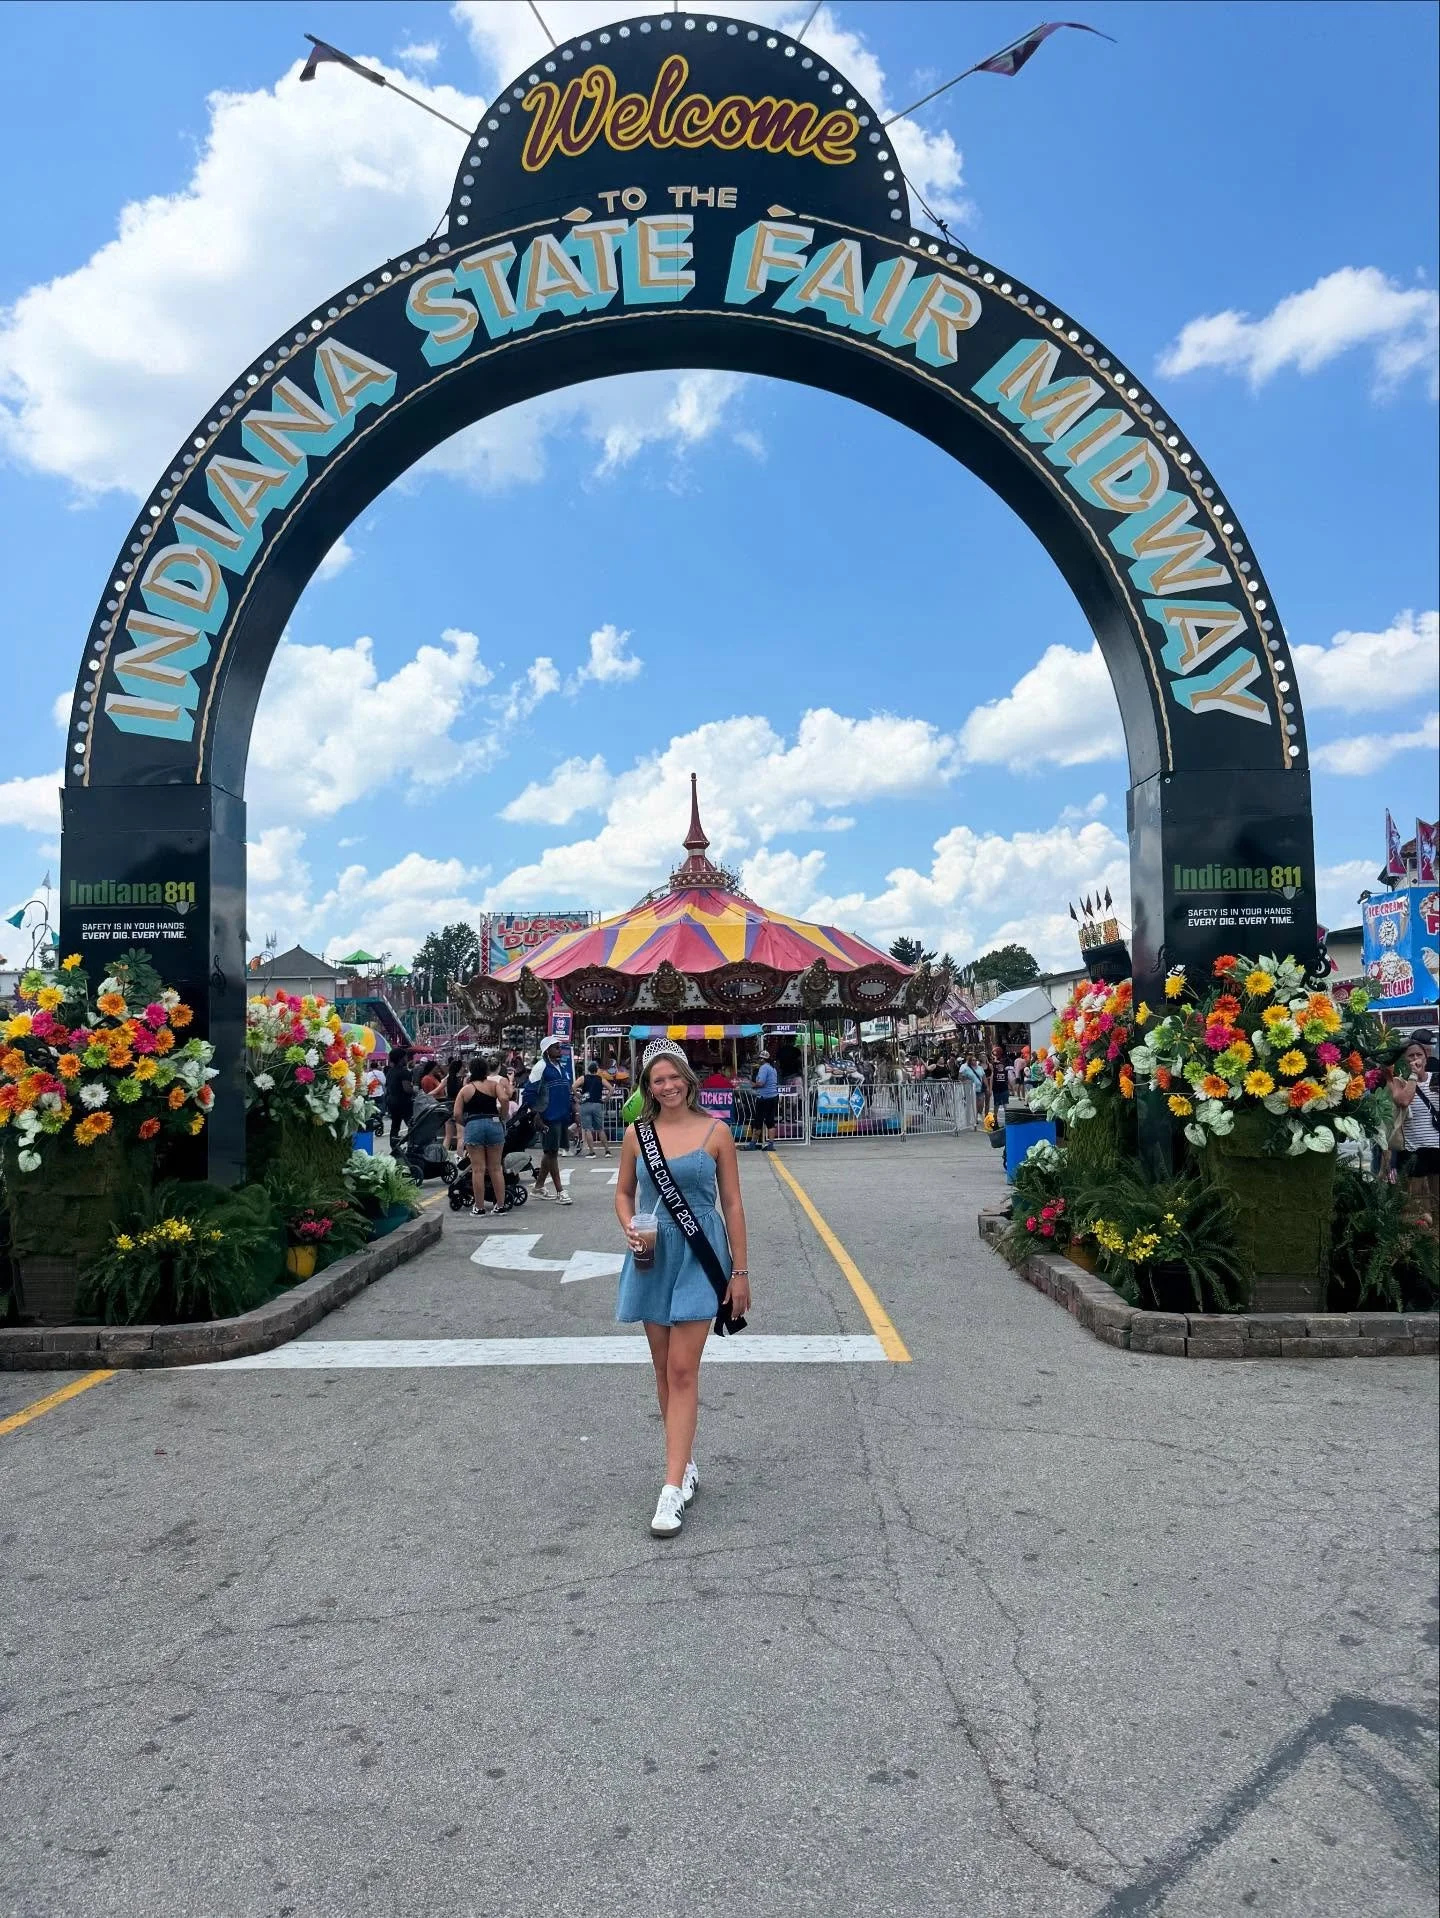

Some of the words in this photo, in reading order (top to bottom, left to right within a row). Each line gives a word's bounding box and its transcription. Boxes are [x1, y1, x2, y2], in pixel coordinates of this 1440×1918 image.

[522, 54, 860, 171] Welcome
[599, 187, 647, 212] TO
[668, 186, 738, 209] THE
[105, 337, 398, 742] INDIANA
[405, 214, 697, 367] STATE
[724, 220, 982, 368] FAIR
[971, 338, 1272, 726] MIDWAY
[1174, 864, 1269, 889] Indiana
[1271, 865, 1302, 888] 811
[70, 880, 162, 904] Indiana
[164, 881, 196, 903] 811
[1187, 908, 1219, 917] SAFETY
[1220, 908, 1229, 916] IS
[1230, 908, 1239, 916] IN
[1240, 907, 1262, 916] YOUR
[1264, 907, 1295, 916] HANDS.
[1368, 904, 1380, 918] ICE
[1380, 900, 1405, 916] CREAM
[82, 922, 112, 931] SAFETY
[113, 922, 122, 930] IS
[123, 922, 132, 930] IN
[134, 922, 155, 930] YOUR
[157, 922, 187, 930] HANDS.
[497, 917, 583, 936] LUCKY
[1188, 917, 1218, 927] EVERY
[1219, 917, 1237, 926] DIG.
[1238, 916, 1269, 925] EVERY
[1270, 916, 1295, 925] TIME.
[82, 931, 111, 940] EVERY
[112, 931, 130, 939] DIG.
[132, 931, 161, 939] EVERY
[162, 930, 187, 939] TIME.
[701, 1091, 733, 1105] TICKETS
[644, 1140, 664, 1171] BOONE
[654, 1169, 684, 1210] COUNTY
[676, 1209, 699, 1237] 2025
